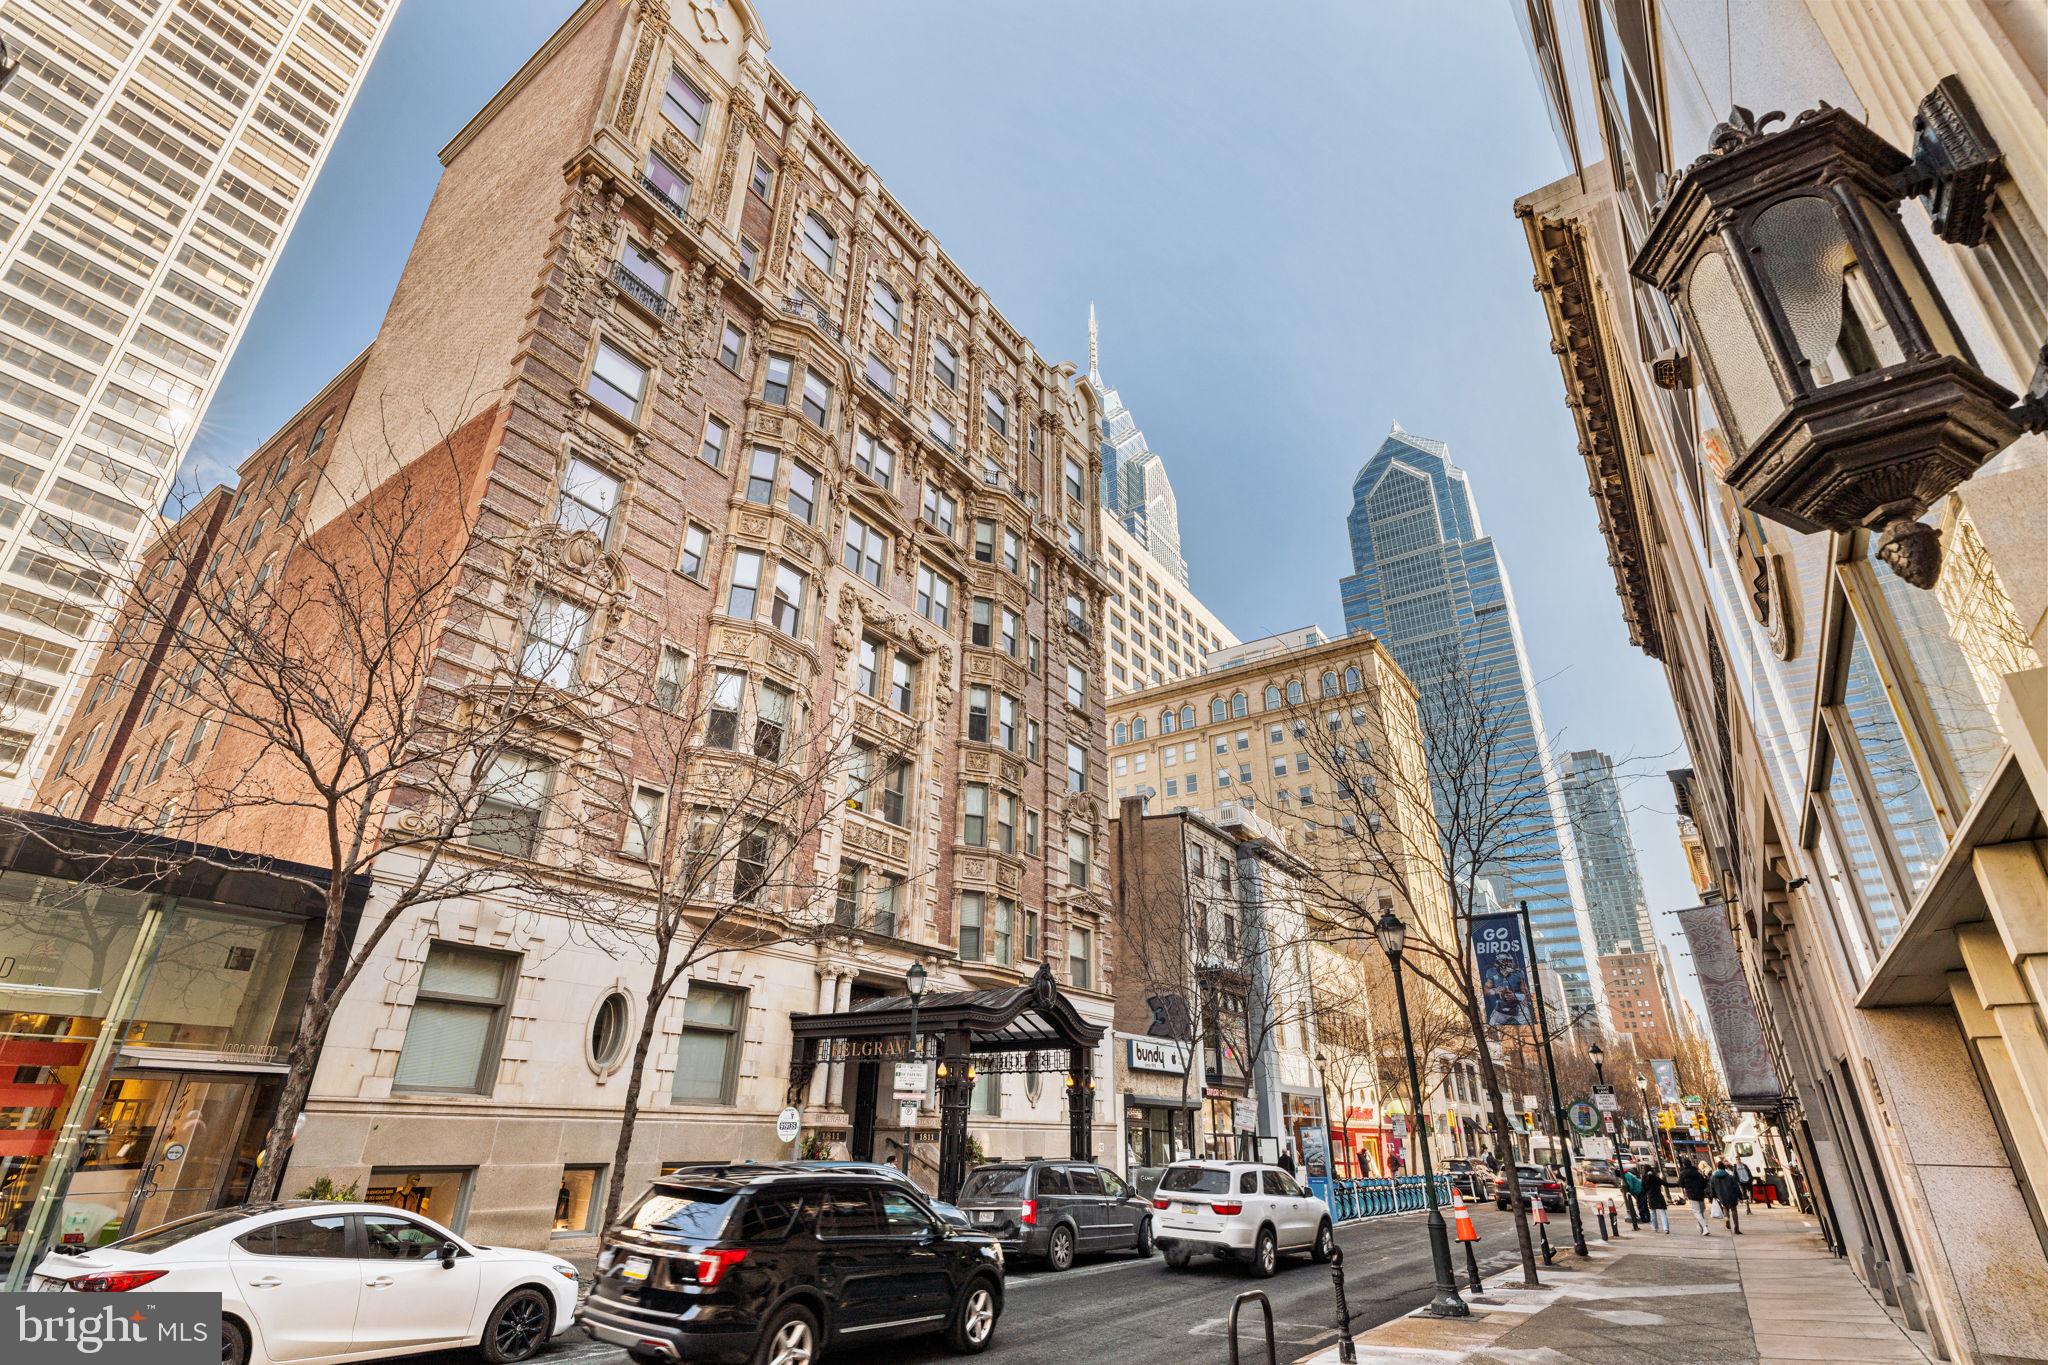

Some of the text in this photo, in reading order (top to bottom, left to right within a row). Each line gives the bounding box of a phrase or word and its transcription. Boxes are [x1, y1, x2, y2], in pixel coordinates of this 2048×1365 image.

[1483, 928, 1508, 941] GO
[1476, 940, 1520, 954] BIRDS
[1136, 1042, 1165, 1068] bundy
[822, 1131, 840, 1140] 1811
[919, 1133, 934, 1141] 1811
